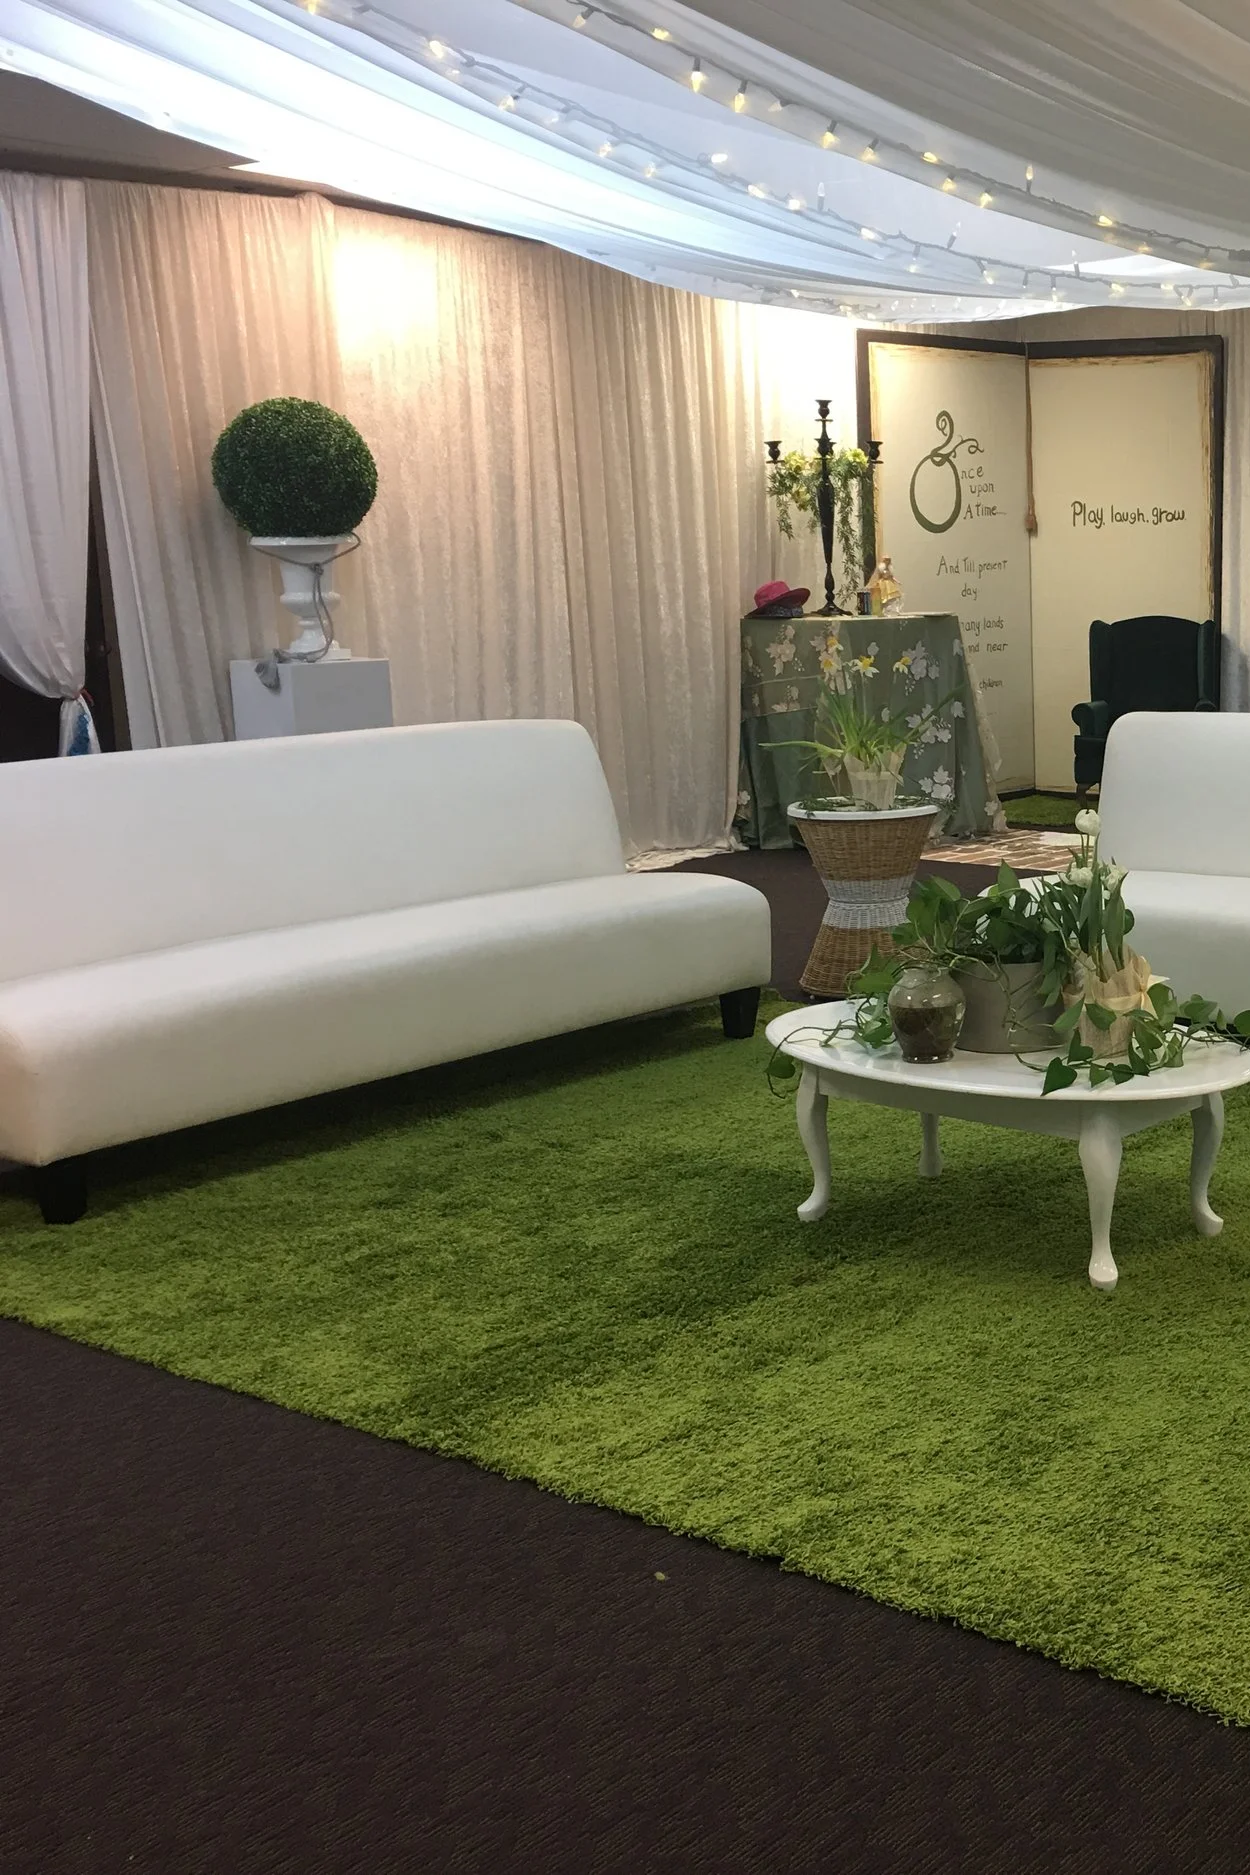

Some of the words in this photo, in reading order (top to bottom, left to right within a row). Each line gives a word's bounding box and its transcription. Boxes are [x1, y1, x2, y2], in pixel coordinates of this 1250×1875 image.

[969, 482, 995, 497] upon
[963, 504, 974, 519] A
[936, 555, 961, 576] And
[978, 559, 1008, 580] present
[983, 616, 1005, 631] lands
[986, 642, 1009, 653] near
